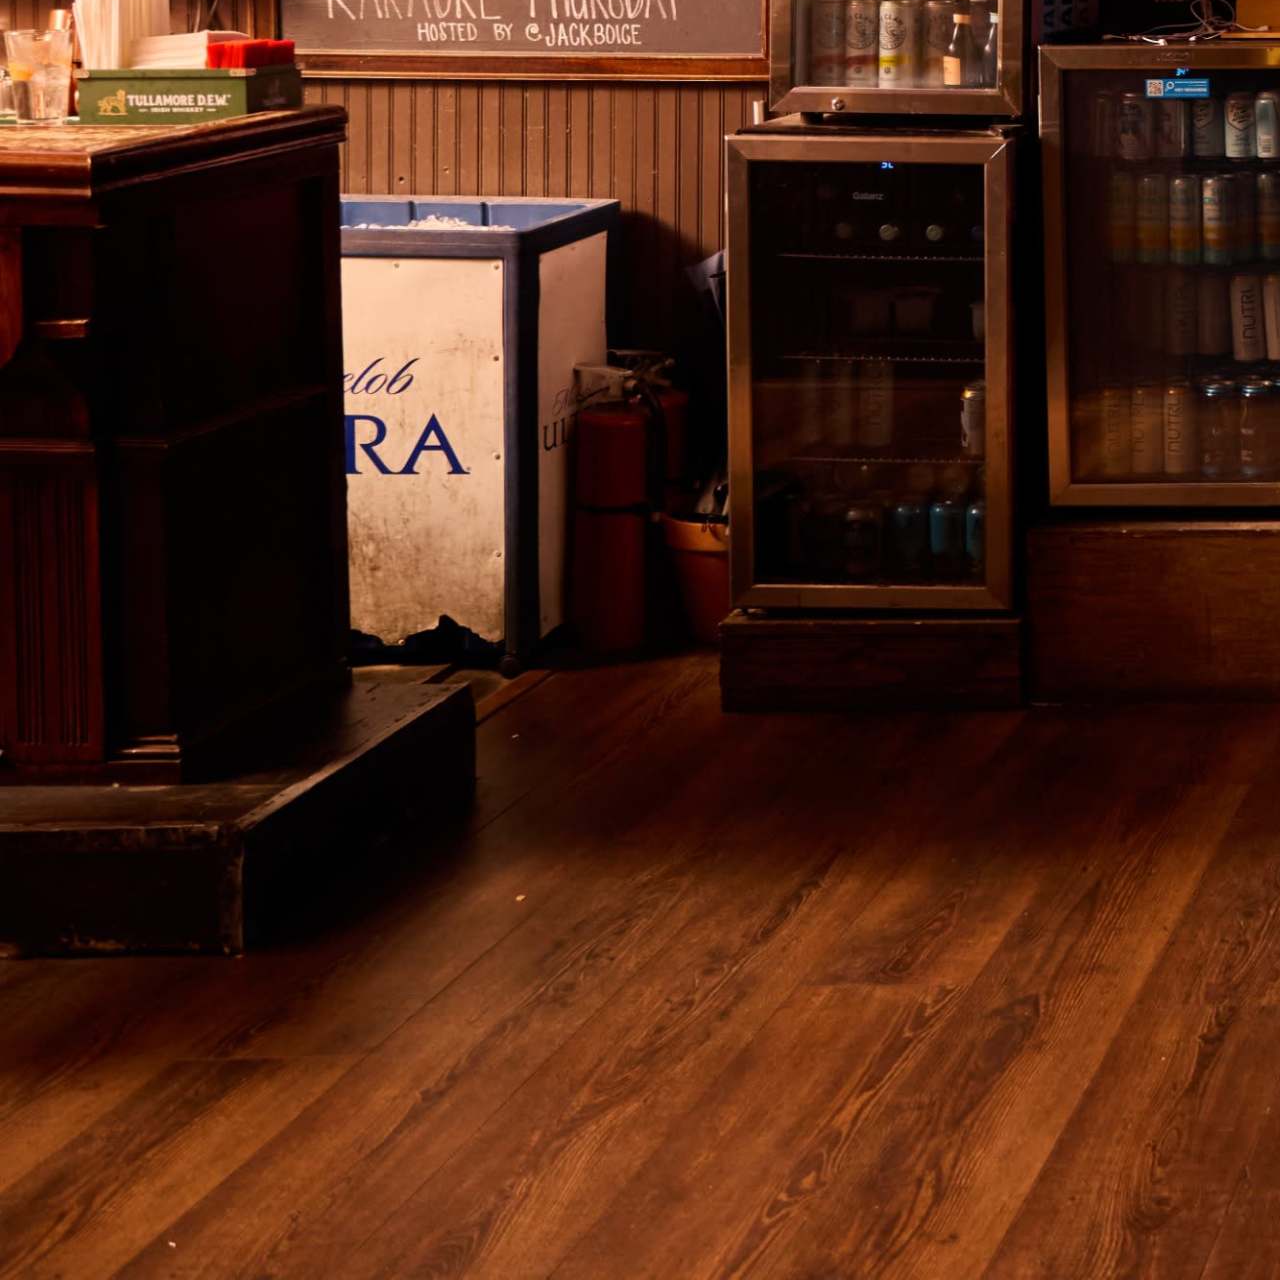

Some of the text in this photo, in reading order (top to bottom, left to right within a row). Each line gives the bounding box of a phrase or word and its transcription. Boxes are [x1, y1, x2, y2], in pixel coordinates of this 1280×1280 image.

[417, 24, 478, 42] HOSTED
[493, 24, 514, 41] BY
[127, 93, 196, 107] TULLAMORE
